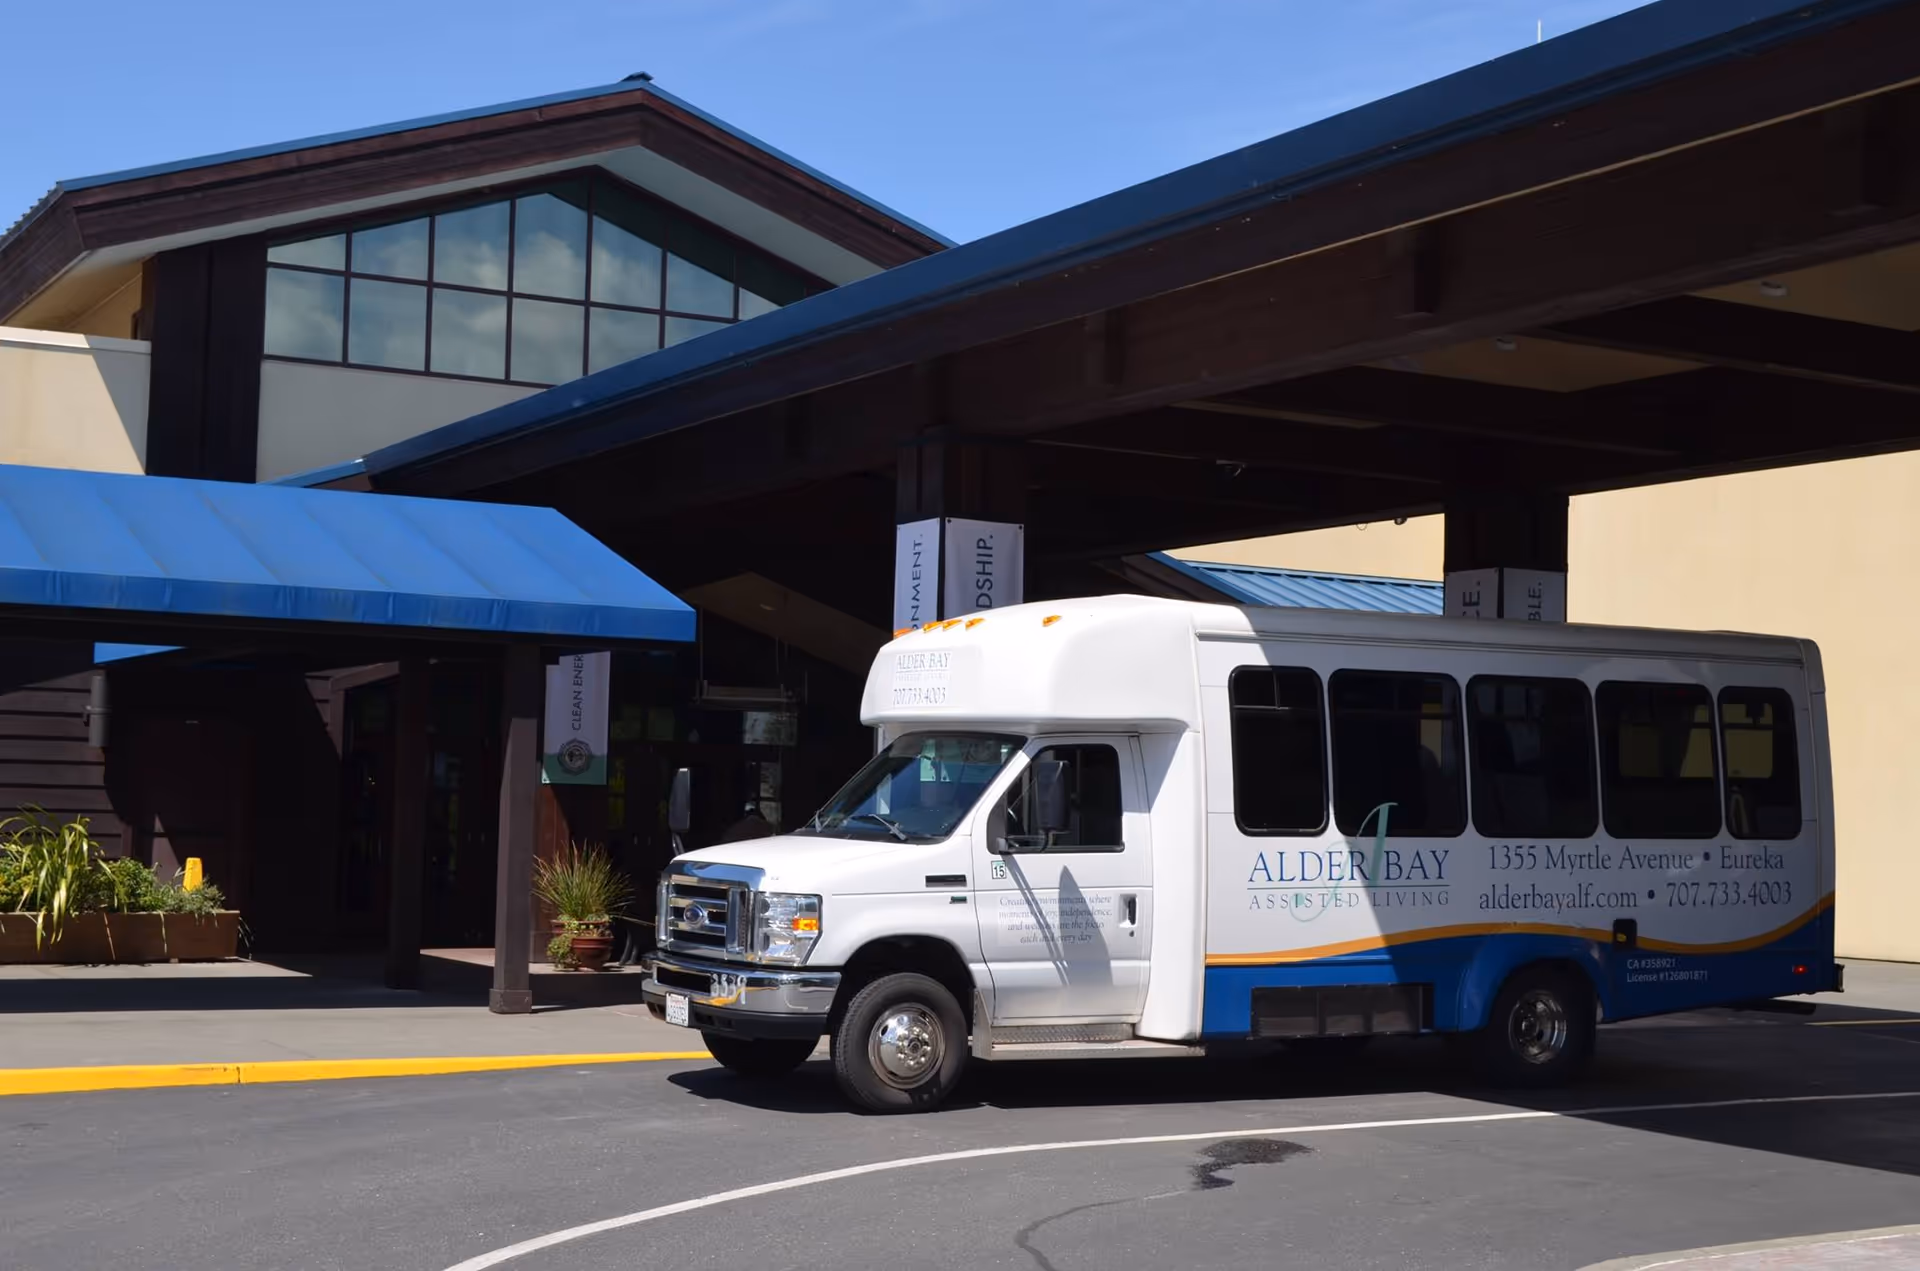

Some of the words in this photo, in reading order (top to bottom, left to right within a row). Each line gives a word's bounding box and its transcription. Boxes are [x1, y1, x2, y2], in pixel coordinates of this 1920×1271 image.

[976, 534, 994, 609] DSHIP.
[929, 653, 951, 668] BAY
[571, 690, 584, 731] CLEAN
[993, 866, 1005, 878] 15
[1248, 850, 1370, 883] ALDER
[1383, 849, 1450, 881] BAY
[1488, 845, 1537, 870] 1355
[1545, 845, 1611, 876] Myrtle
[1618, 845, 1694, 870] Avenue
[1720, 845, 1785, 870] Eureka
[1249, 893, 1361, 910] ASSISTED
[1373, 891, 1450, 908] LIVING
[1479, 883, 1638, 914] alderbayalf.com
[1666, 881, 1792, 907] 707.733.4003
[1626, 959, 1640, 970] CA
[1626, 971, 1658, 983] License
